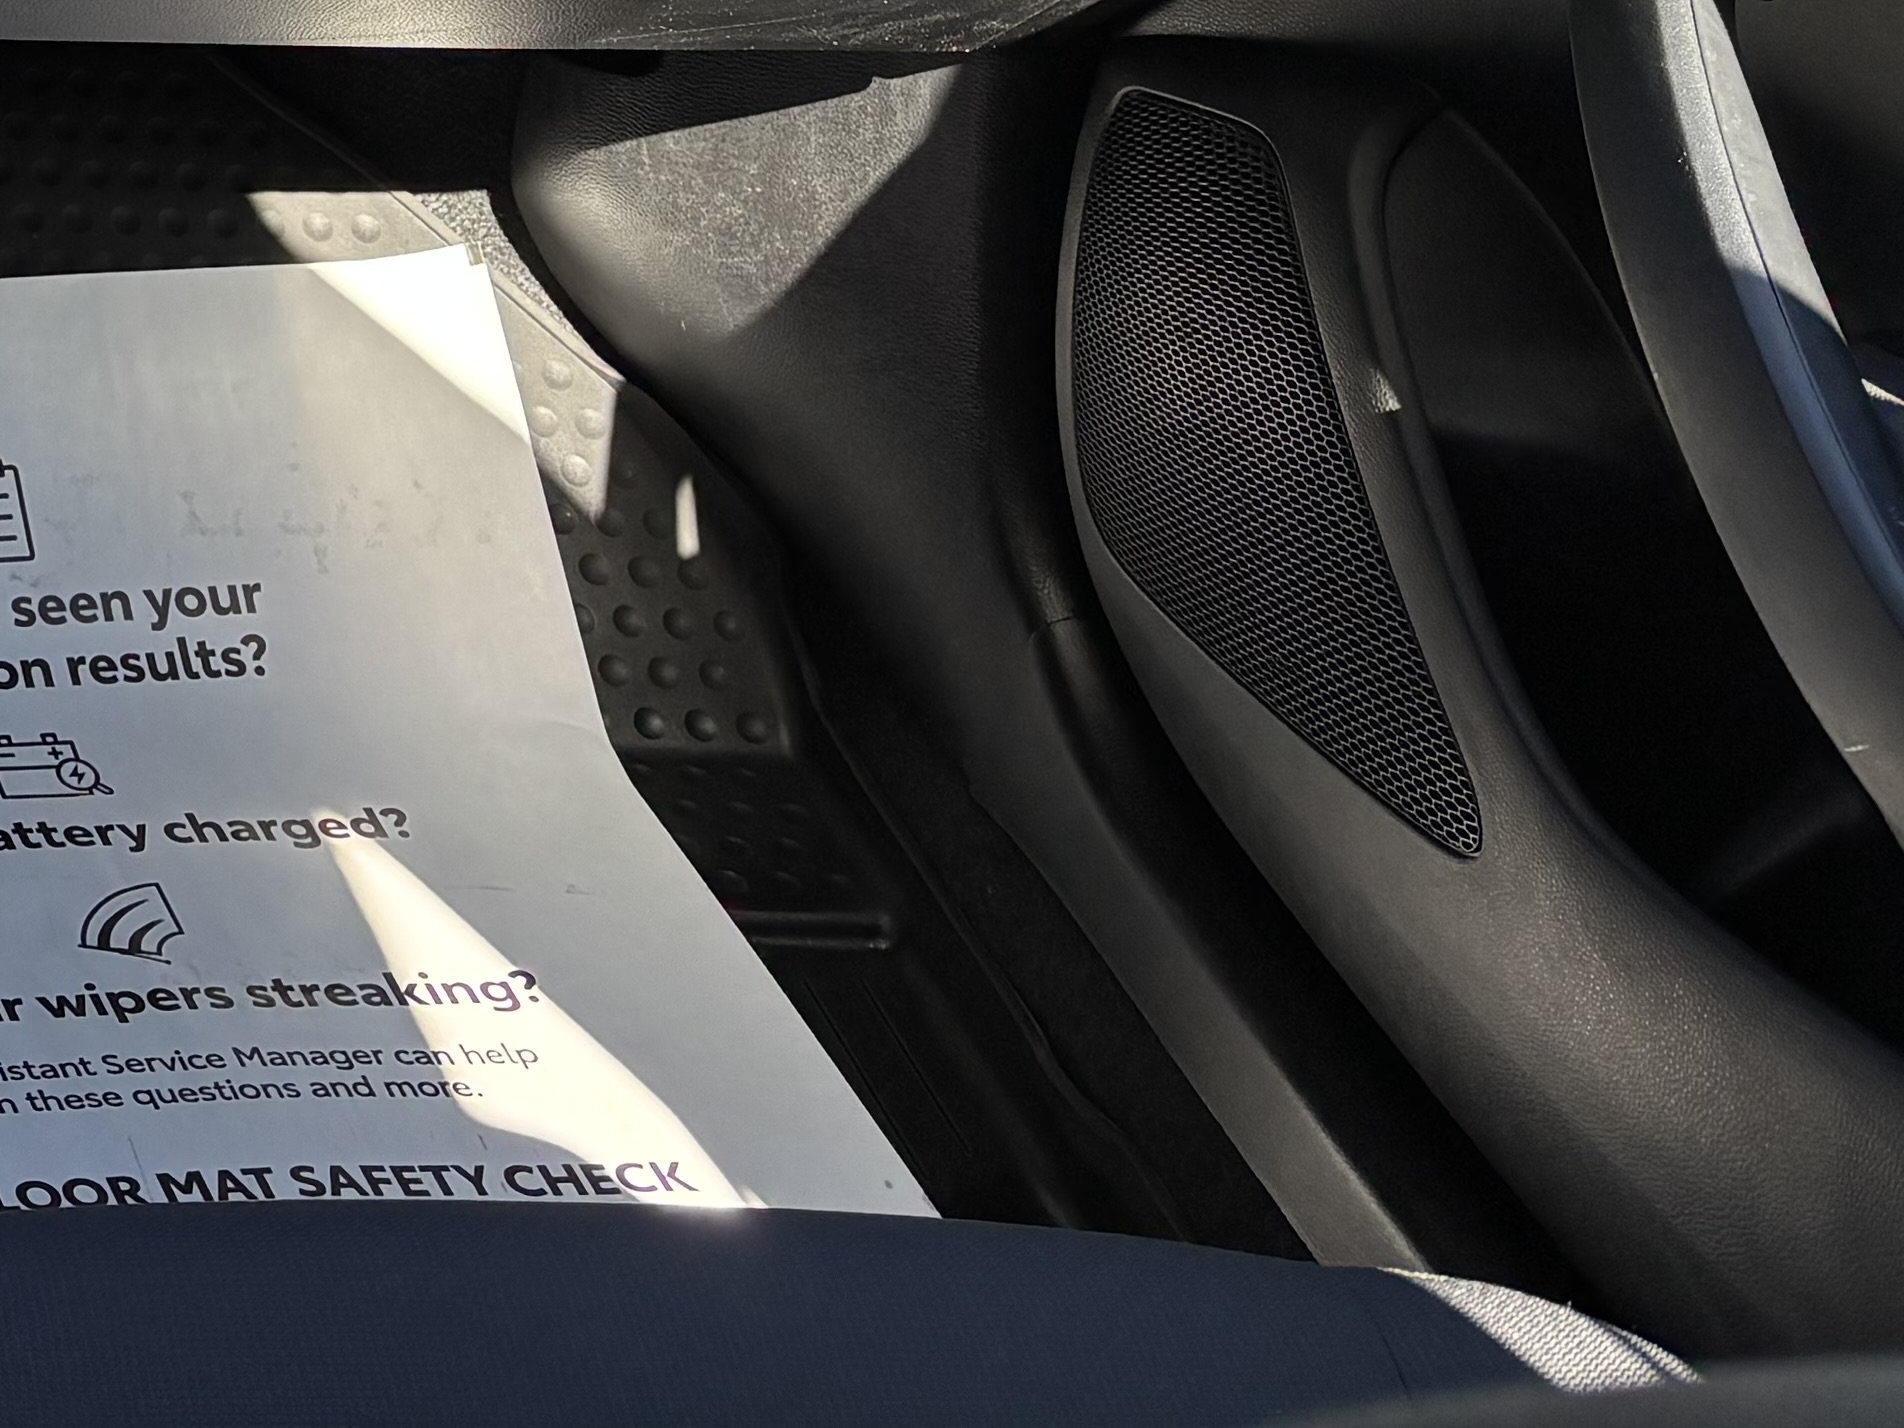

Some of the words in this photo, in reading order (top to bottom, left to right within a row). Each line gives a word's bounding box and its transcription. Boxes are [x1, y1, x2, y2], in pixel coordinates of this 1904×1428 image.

[11, 588, 134, 628] seen
[142, 581, 262, 631] your
[66, 634, 267, 686] results?
[163, 807, 411, 849] charged?
[35, 982, 234, 1024] wipers
[245, 969, 540, 1012] streaking?
[101, 1050, 227, 1075] Service
[232, 1046, 383, 1071] Manager
[394, 1048, 456, 1066] can
[459, 1042, 539, 1069] help
[25, 1089, 124, 1113] these
[132, 1078, 301, 1111] questions
[310, 1075, 376, 1098] and
[384, 1078, 483, 1099] more.
[155, 1166, 273, 1203] MAT
[289, 1164, 489, 1197] SAFETY
[503, 1161, 699, 1197] CHECK
